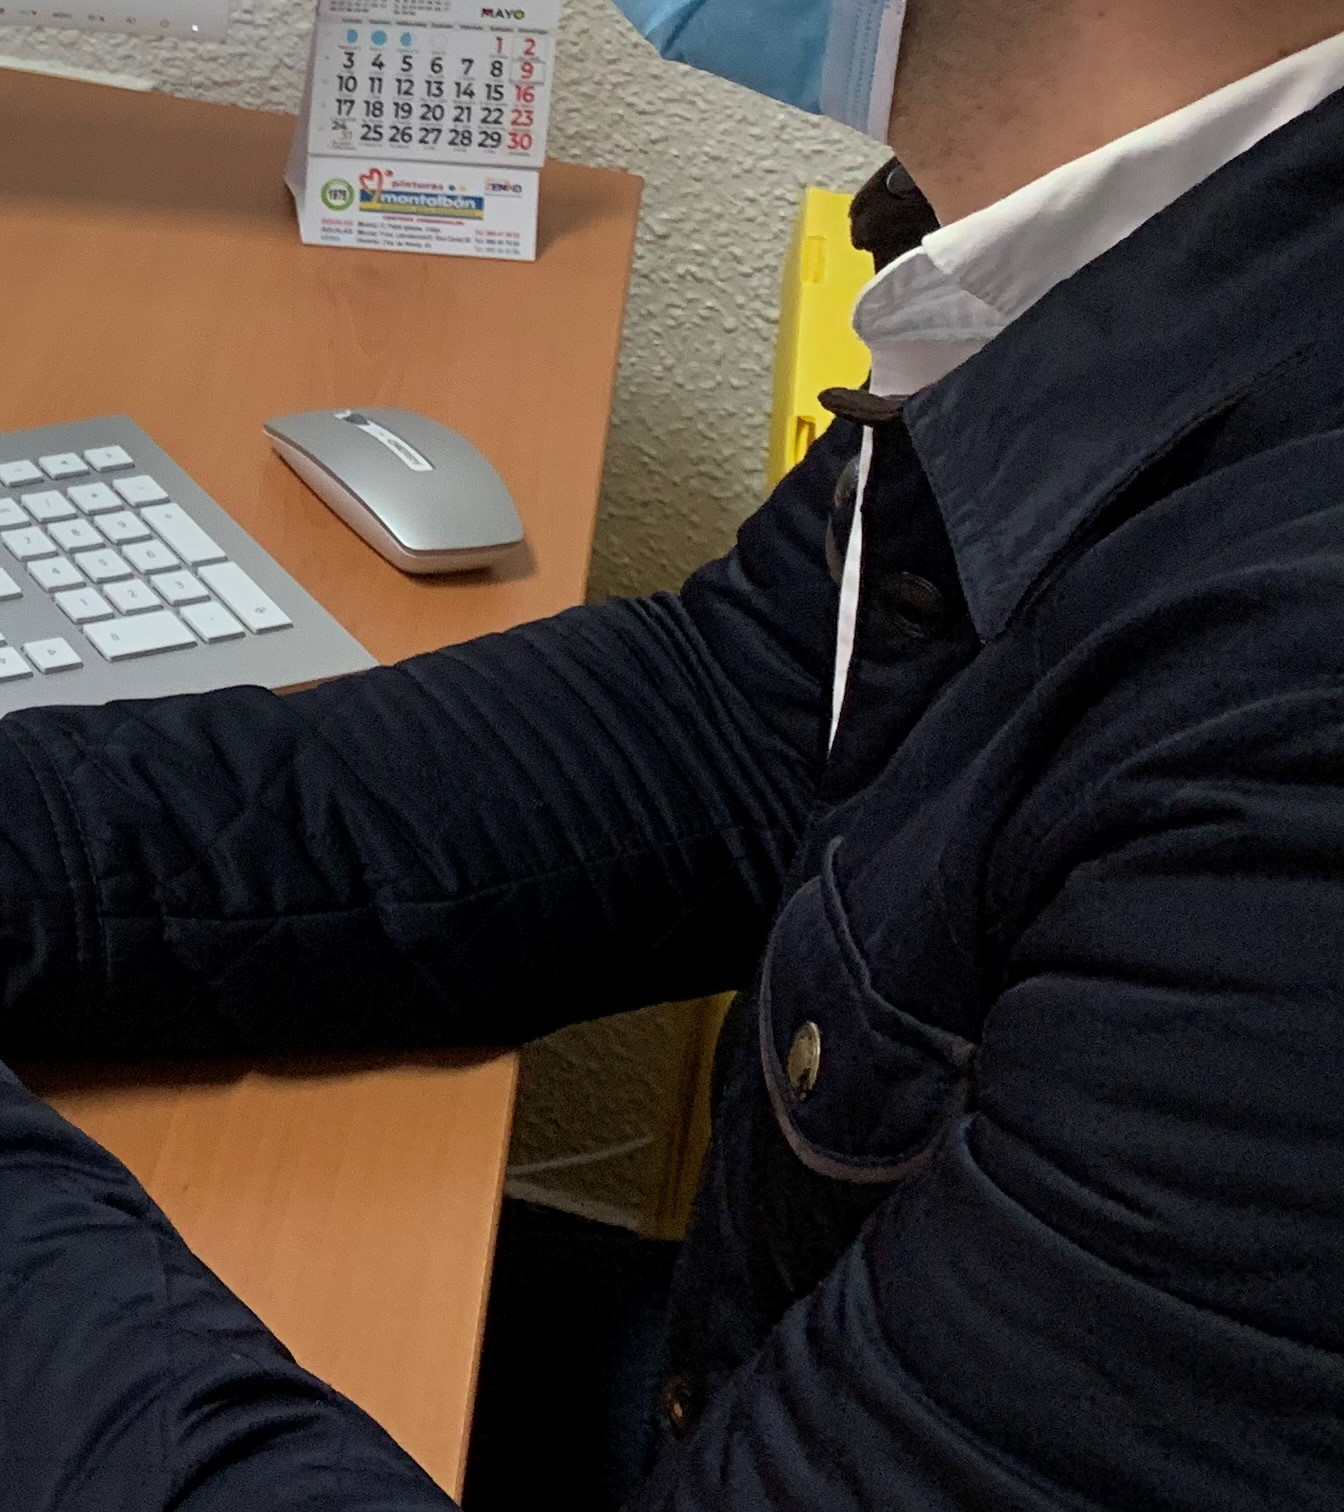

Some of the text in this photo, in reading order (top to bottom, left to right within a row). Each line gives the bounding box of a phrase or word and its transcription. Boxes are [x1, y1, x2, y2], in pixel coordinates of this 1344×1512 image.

[496, 37, 536, 56] 1 2
[343, 52, 534, 79] 3 4 5 6 7 8 9
[337, 75, 535, 103] 10 11 12 13 14 15 16
[336, 98, 534, 127] 17 18 19 20 21 22 23
[360, 124, 384, 142] 25
[389, 125, 413, 144] 26
[418, 127, 442, 145] 27
[448, 129, 472, 147] 28
[478, 131, 502, 149] 29
[507, 132, 532, 150] 30
